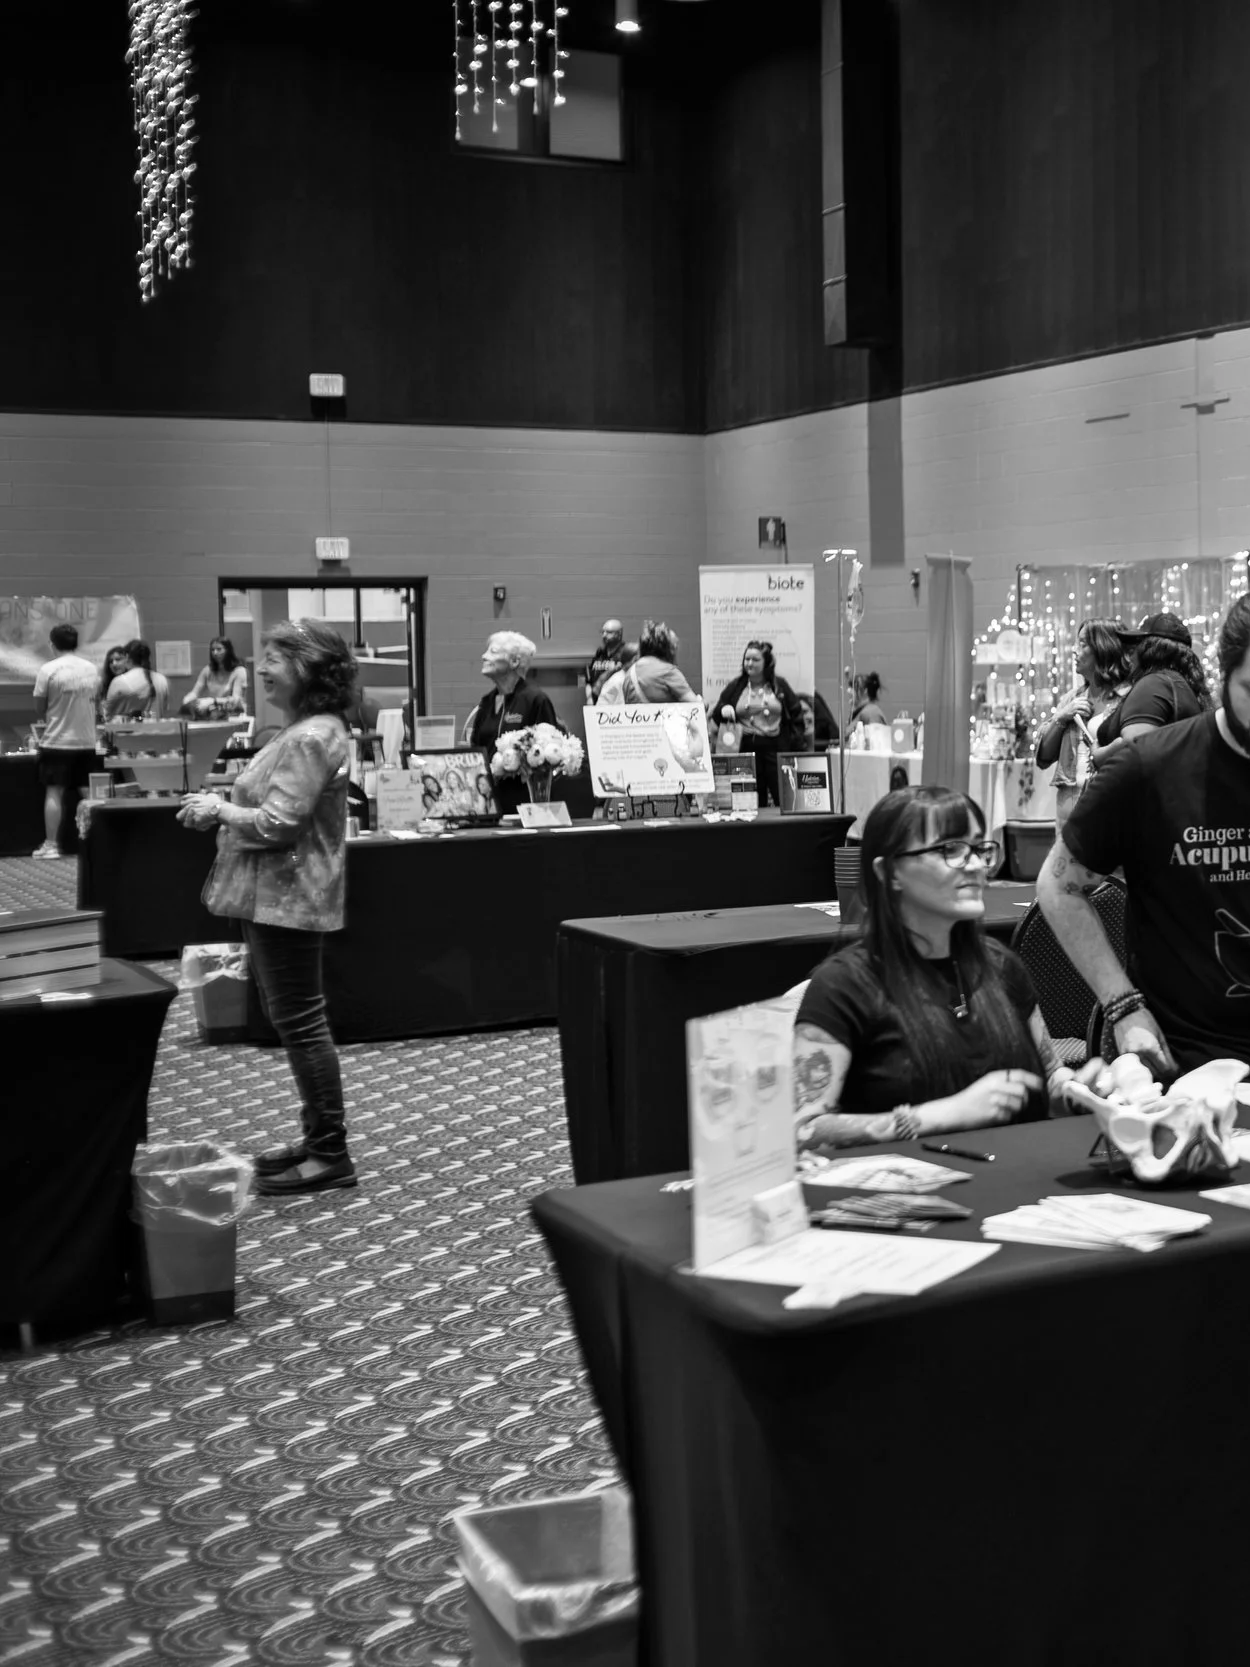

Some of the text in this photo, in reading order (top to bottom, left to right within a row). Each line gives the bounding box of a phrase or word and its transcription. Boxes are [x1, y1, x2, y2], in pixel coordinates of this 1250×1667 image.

[767, 575, 805, 590] biote
[735, 595, 781, 605] experience
[596, 711, 623, 725] Did
[624, 710, 651, 724] You
[1183, 826, 1245, 845] Ginger
[1210, 872, 1234, 882] and
